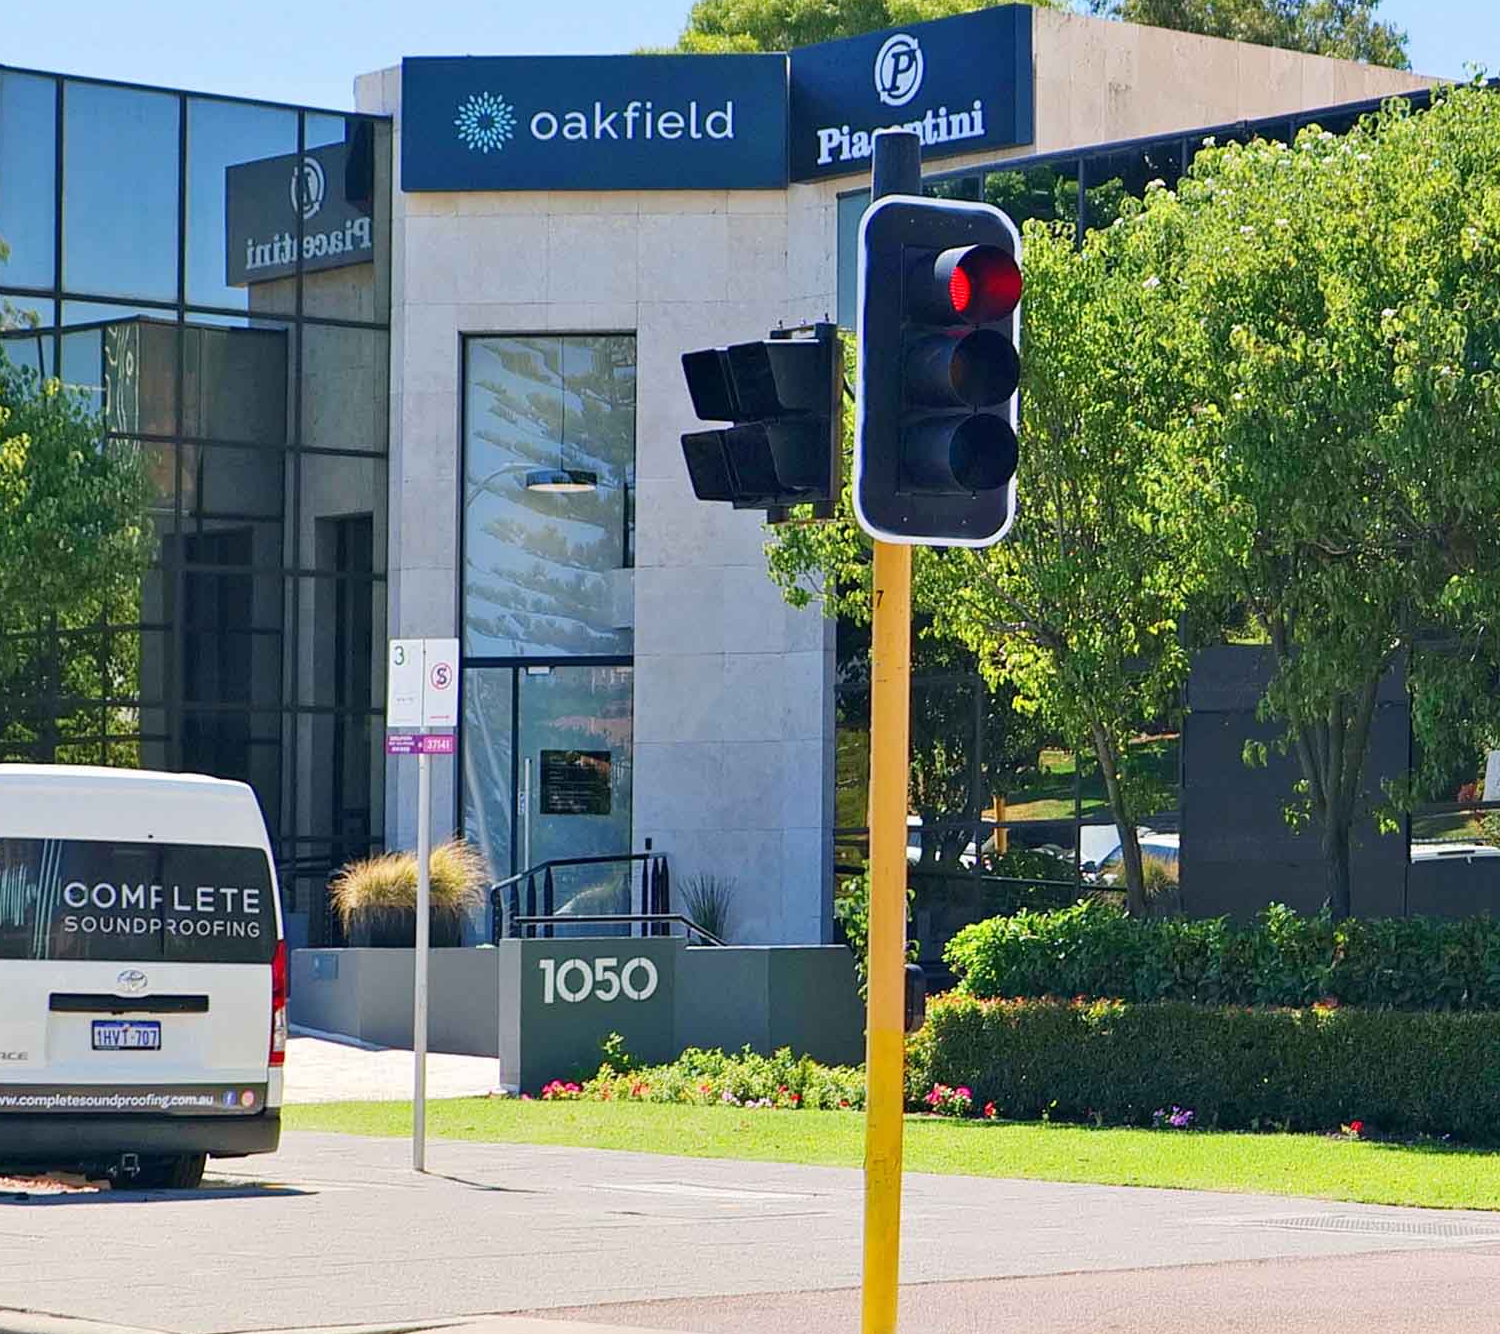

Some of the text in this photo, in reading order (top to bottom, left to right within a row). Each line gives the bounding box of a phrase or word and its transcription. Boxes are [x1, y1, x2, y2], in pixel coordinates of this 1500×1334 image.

[530, 100, 735, 141] oakfield
[816, 100, 985, 165] Piantini
[63, 882, 260, 913] COMPLETE
[64, 916, 260, 938] SOUNDPROOFING
[538, 957, 658, 1004] 1050
